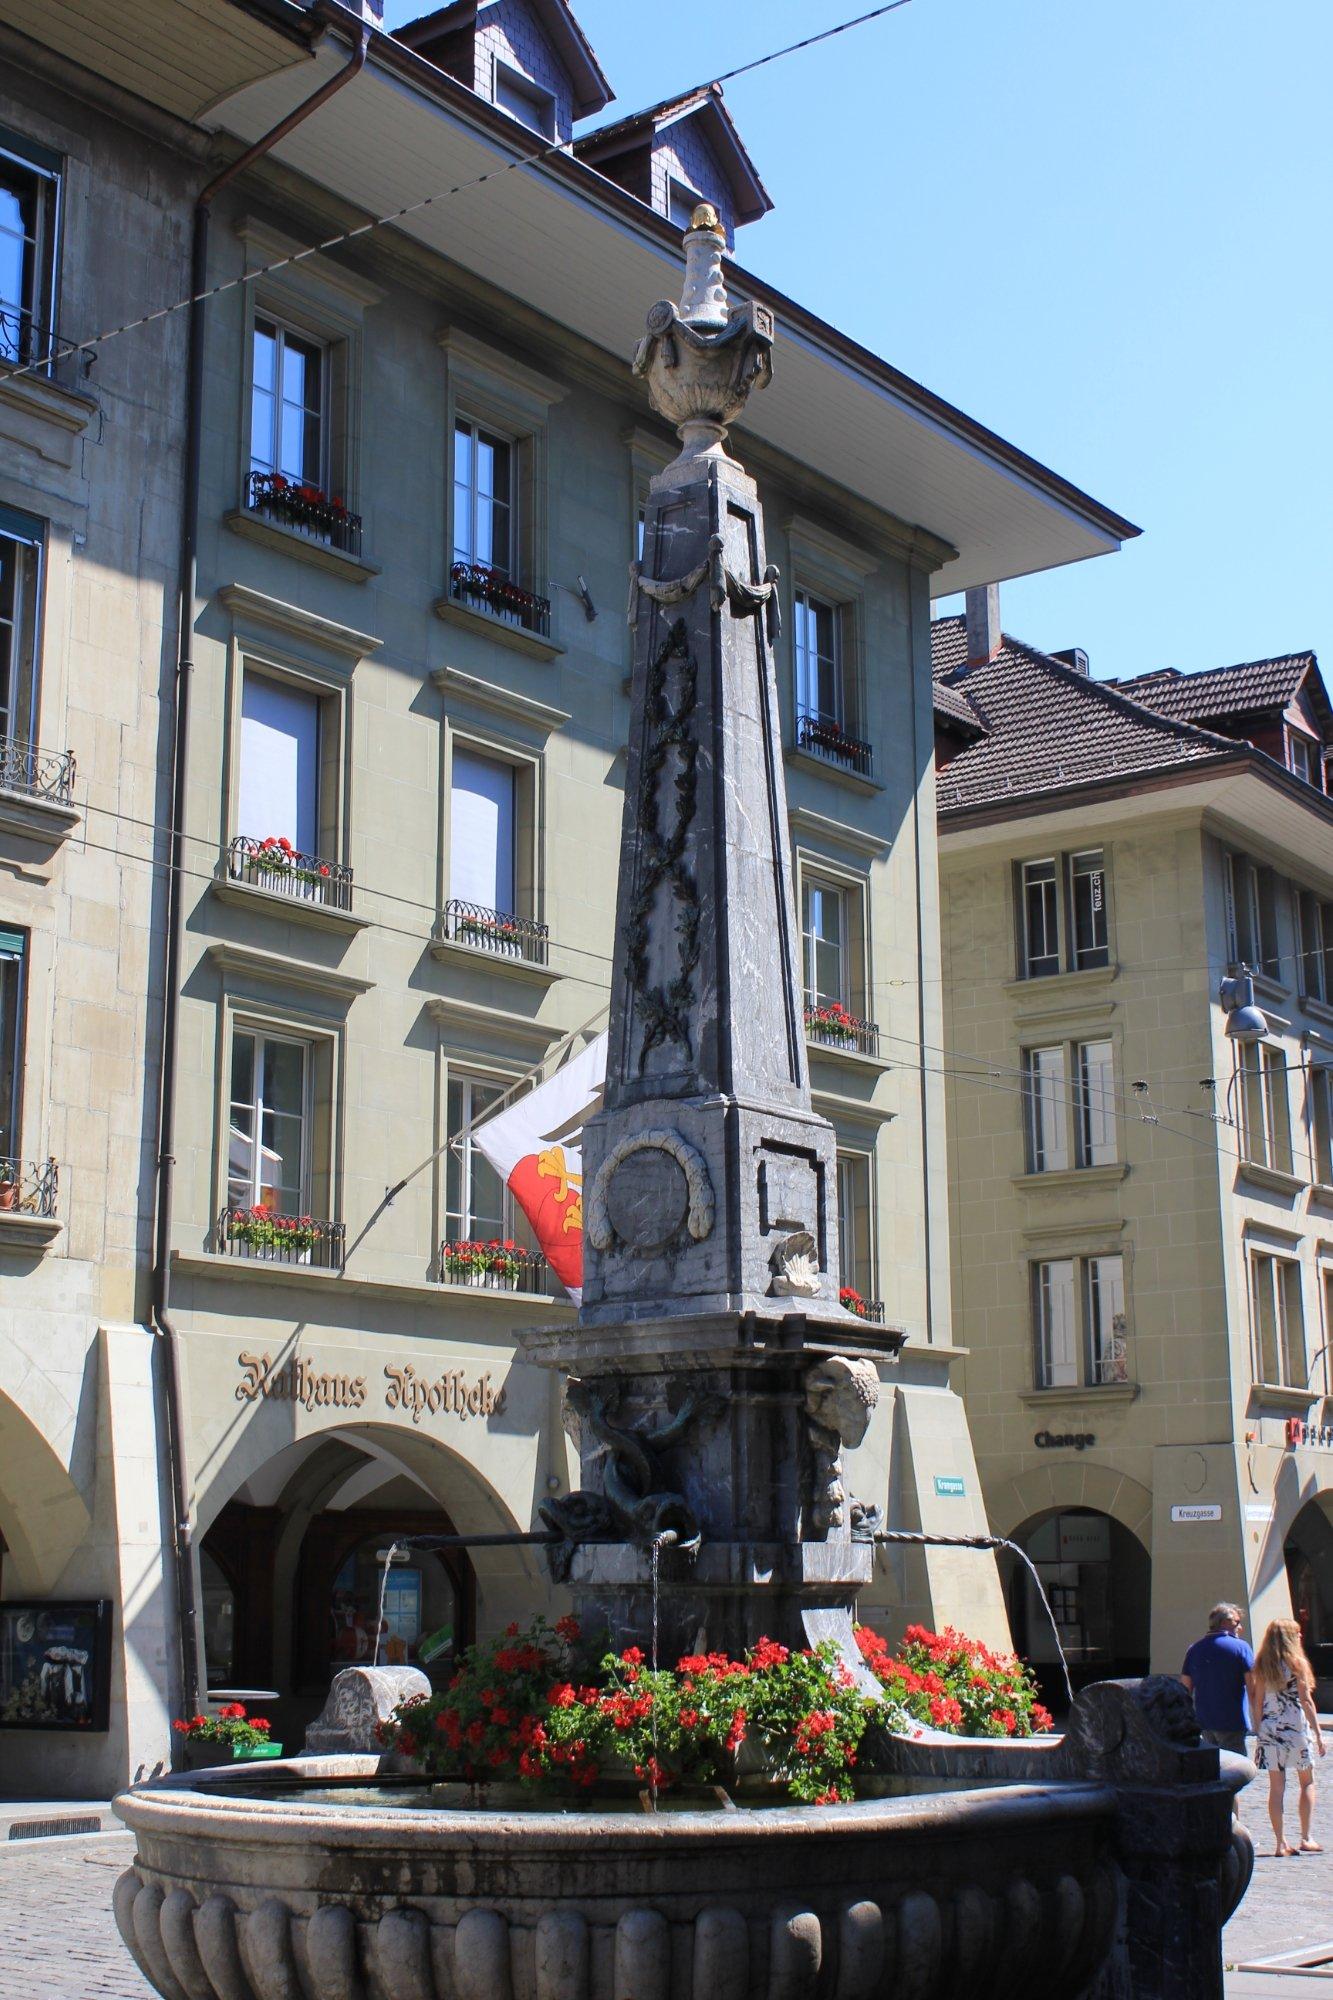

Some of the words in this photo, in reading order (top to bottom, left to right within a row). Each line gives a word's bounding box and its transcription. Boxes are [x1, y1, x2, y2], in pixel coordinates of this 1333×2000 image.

[1093, 872, 1102, 911] feuz.ch
[235, 1351, 367, 1412] Rathaus
[384, 1363, 507, 1423] Apotheke
[1034, 1430, 1095, 1451] Change
[1178, 1509, 1214, 1519] Kreuzgasse
